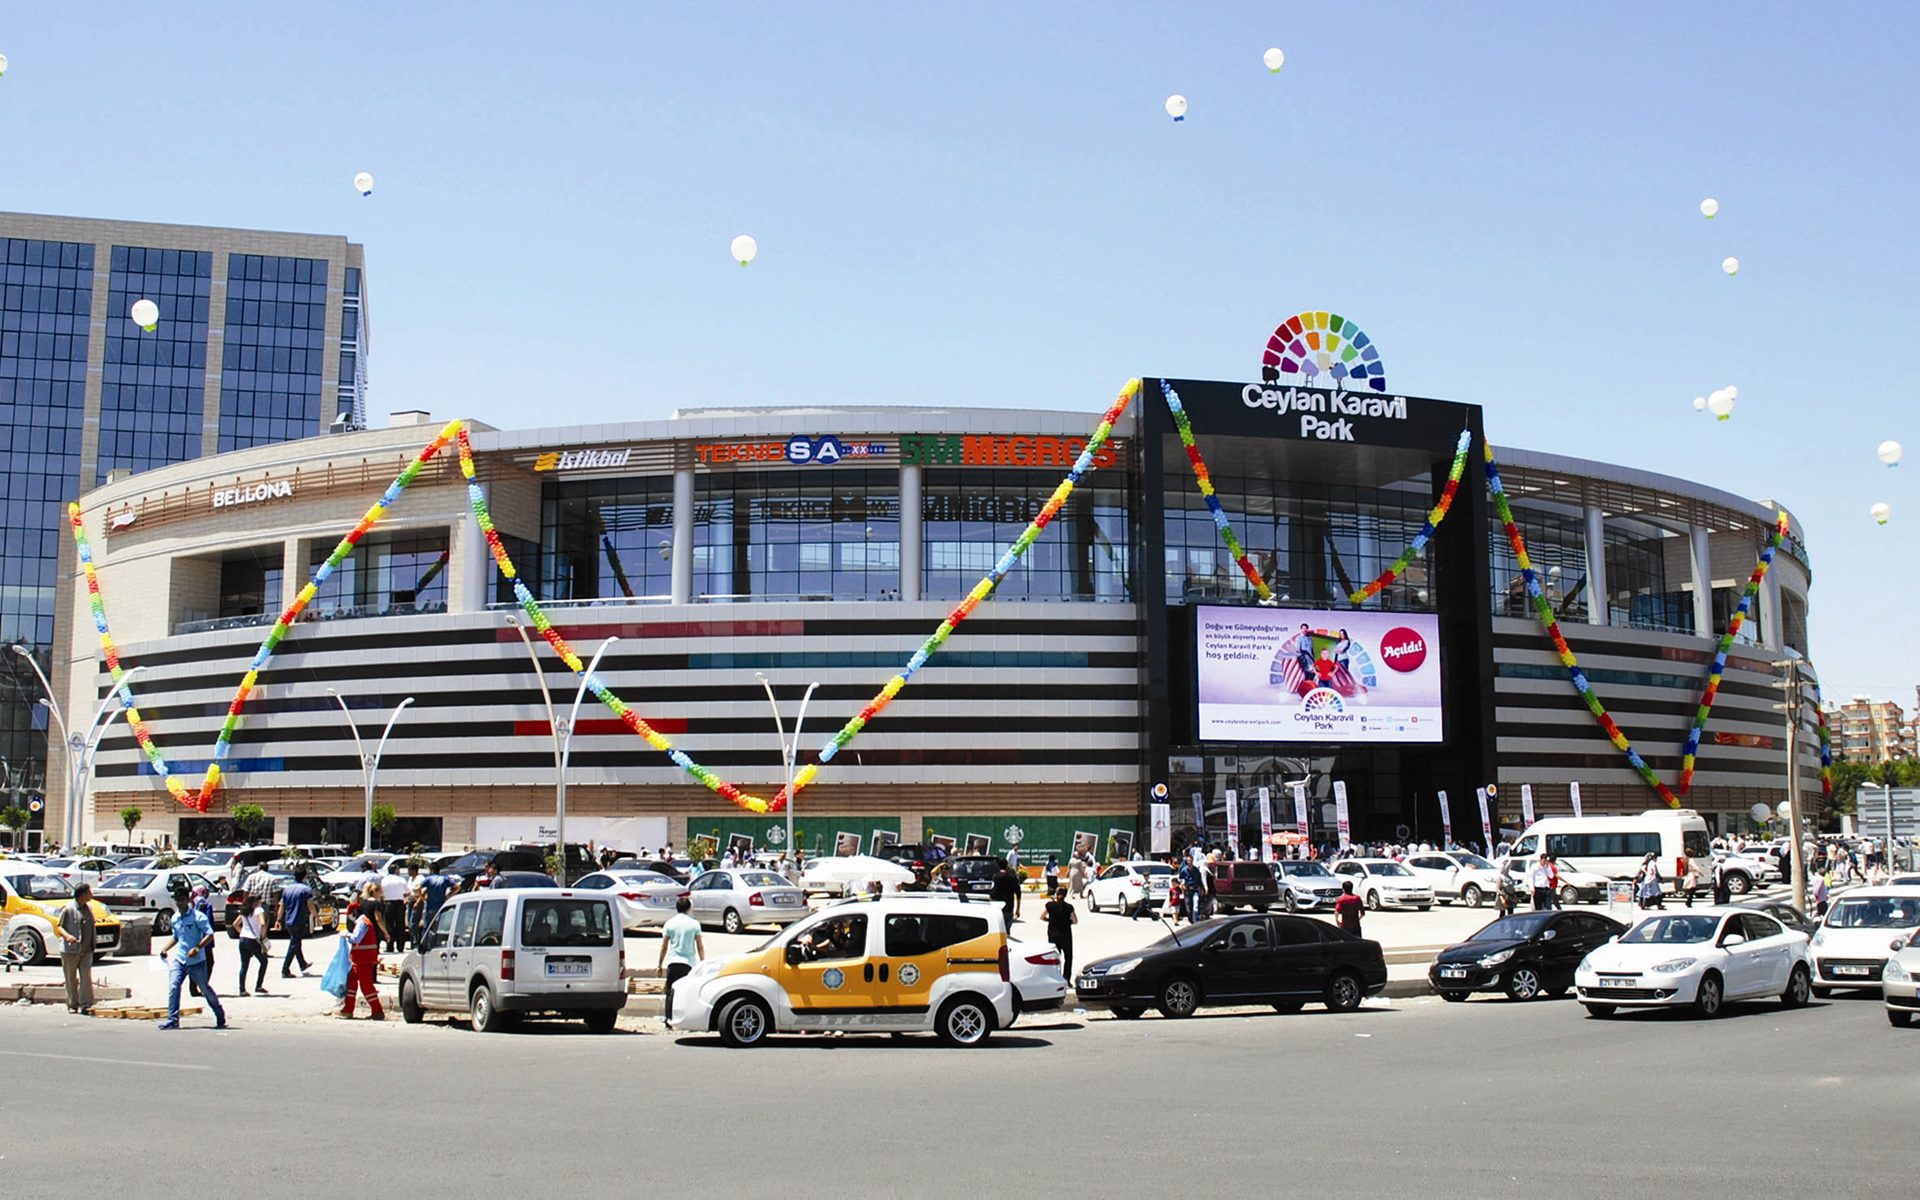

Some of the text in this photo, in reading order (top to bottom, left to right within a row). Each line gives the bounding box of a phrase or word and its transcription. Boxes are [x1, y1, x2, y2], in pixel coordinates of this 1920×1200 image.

[1242, 383, 1408, 420] Ceylan Karavil
[1301, 414, 1355, 441] Park
[213, 480, 293, 508] BELLONA
[1205, 622, 1224, 631] Doğu
[1234, 623, 1289, 633] Güneydoğu'nun
[1206, 651, 1260, 661] hoş geldiniz.
[1384, 640, 1423, 659] Açıldı!
[1294, 713, 1354, 722] Ceylan Karavil
